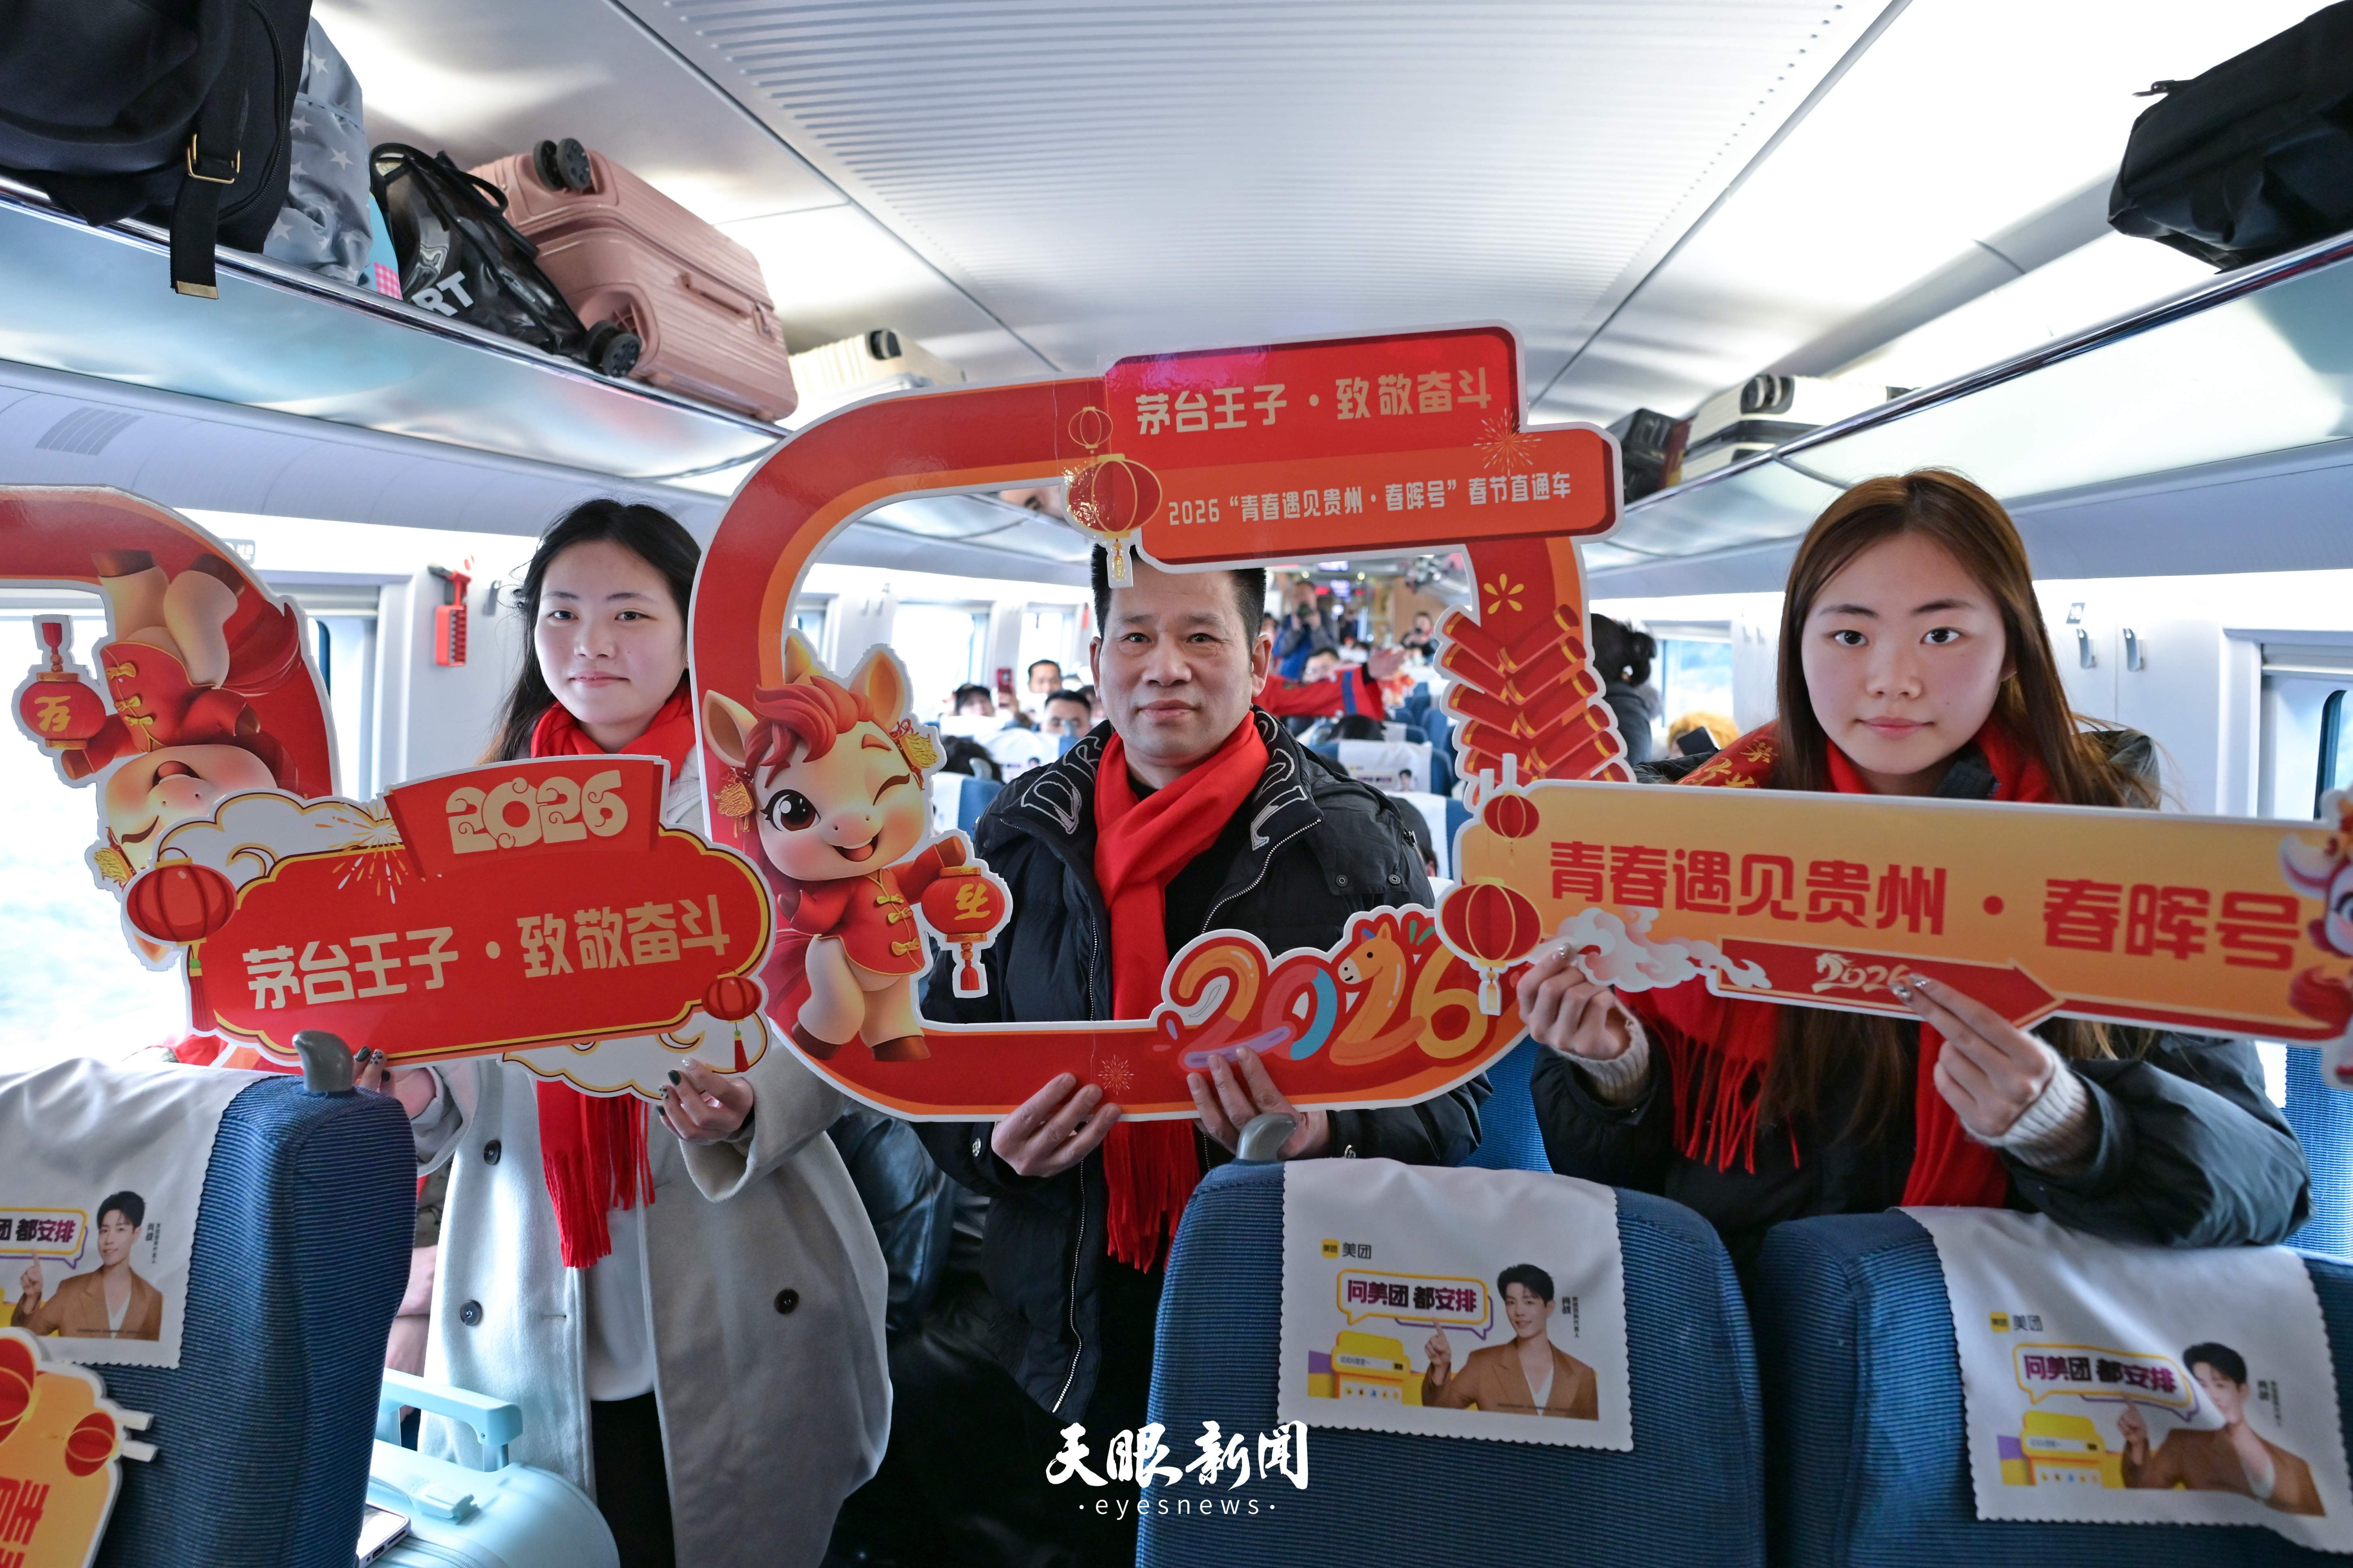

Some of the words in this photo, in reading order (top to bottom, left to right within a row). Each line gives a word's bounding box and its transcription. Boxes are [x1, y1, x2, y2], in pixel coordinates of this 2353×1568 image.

[1135, 367, 1492, 435] 茅台王子·致敬奋斗
[1168, 498, 1220, 526] 2026
[446, 769, 628, 854] 2026
[1550, 841, 2301, 970] 青春遇见贵州·春晖号
[243, 894, 731, 1010] 茅台王子·致敬奋斗
[16, 1218, 76, 1243] 都安排
[1342, 1242, 1372, 1259] 美团
[1347, 1279, 1409, 1308] 问美团
[1413, 1286, 1477, 1313] 都安排
